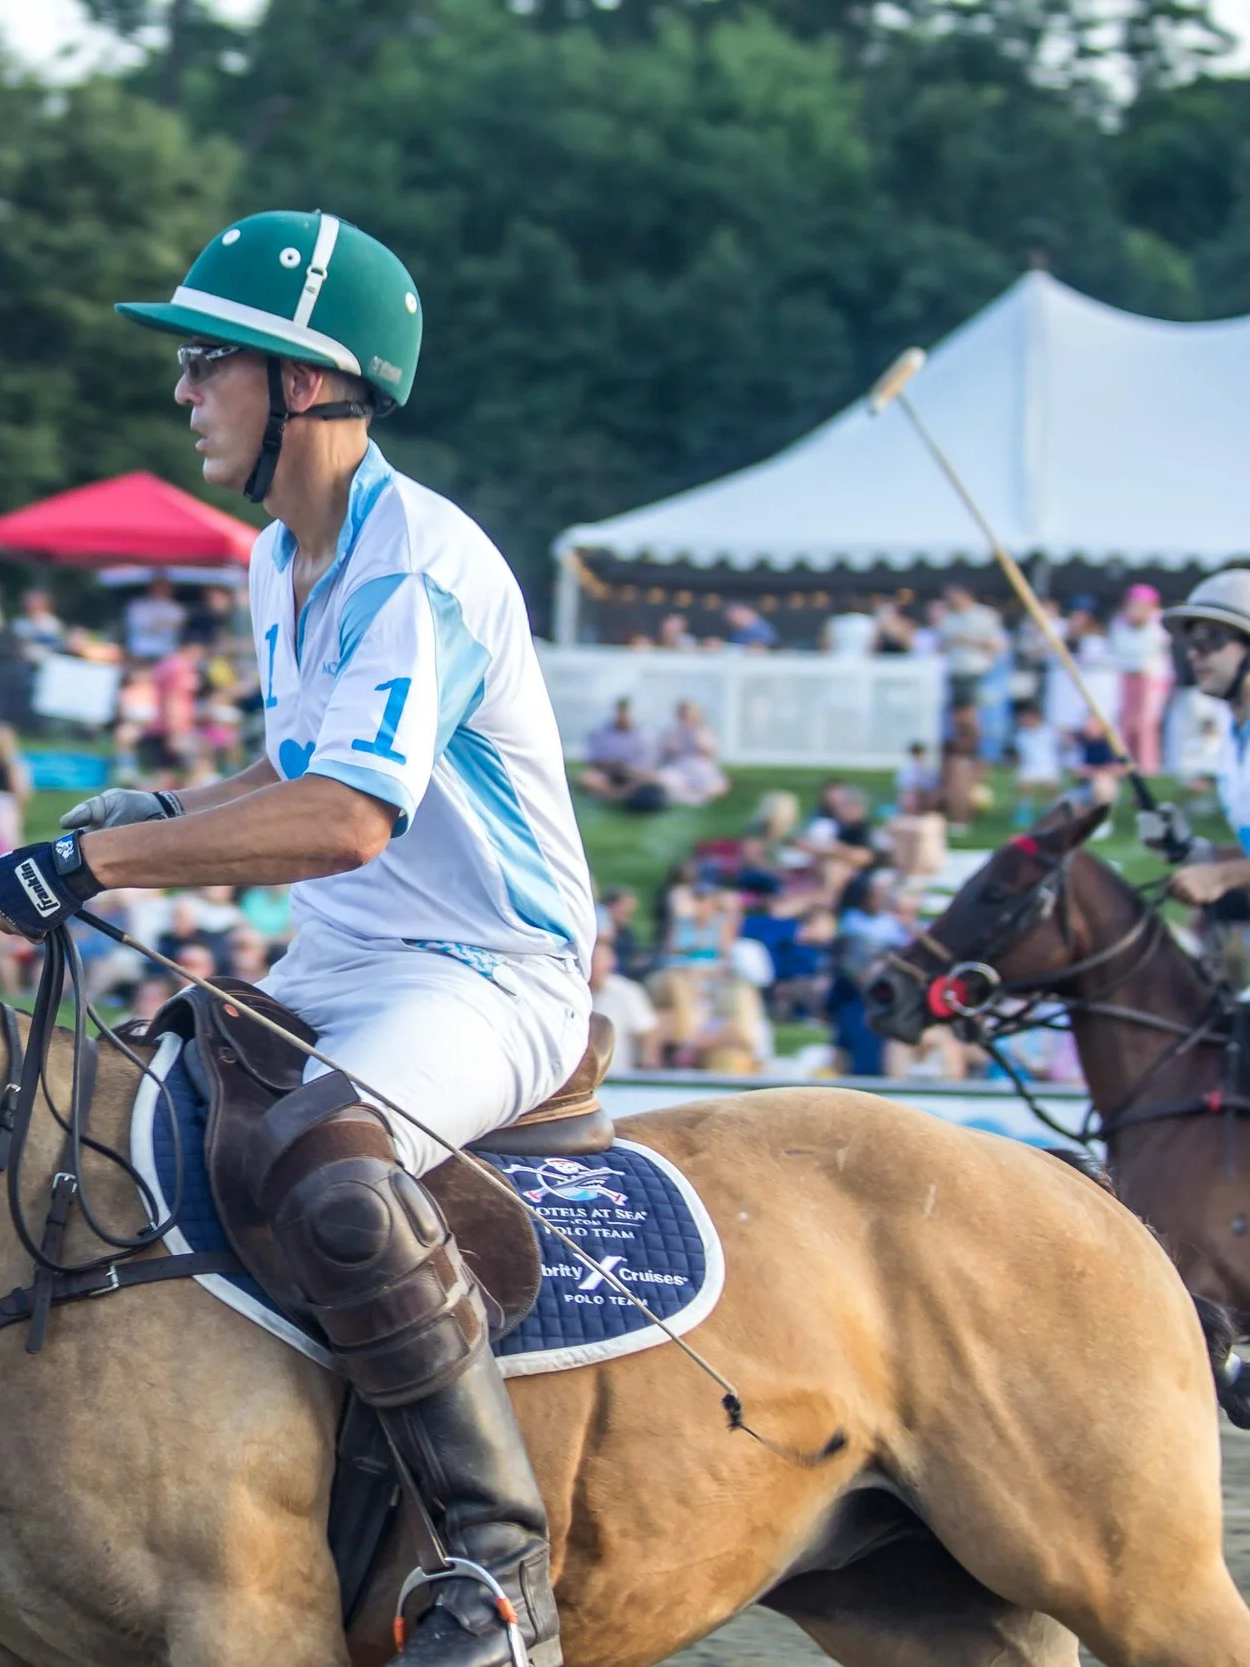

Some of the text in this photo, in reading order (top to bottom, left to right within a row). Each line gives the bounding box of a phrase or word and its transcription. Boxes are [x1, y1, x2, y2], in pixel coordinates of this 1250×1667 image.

[265, 623, 279, 709] 1
[351, 677, 412, 765] 1
[591, 1208, 612, 1218] AT
[591, 1228, 636, 1239] TEAM
[541, 1263, 582, 1280] brity
[564, 1294, 604, 1304] POLO
